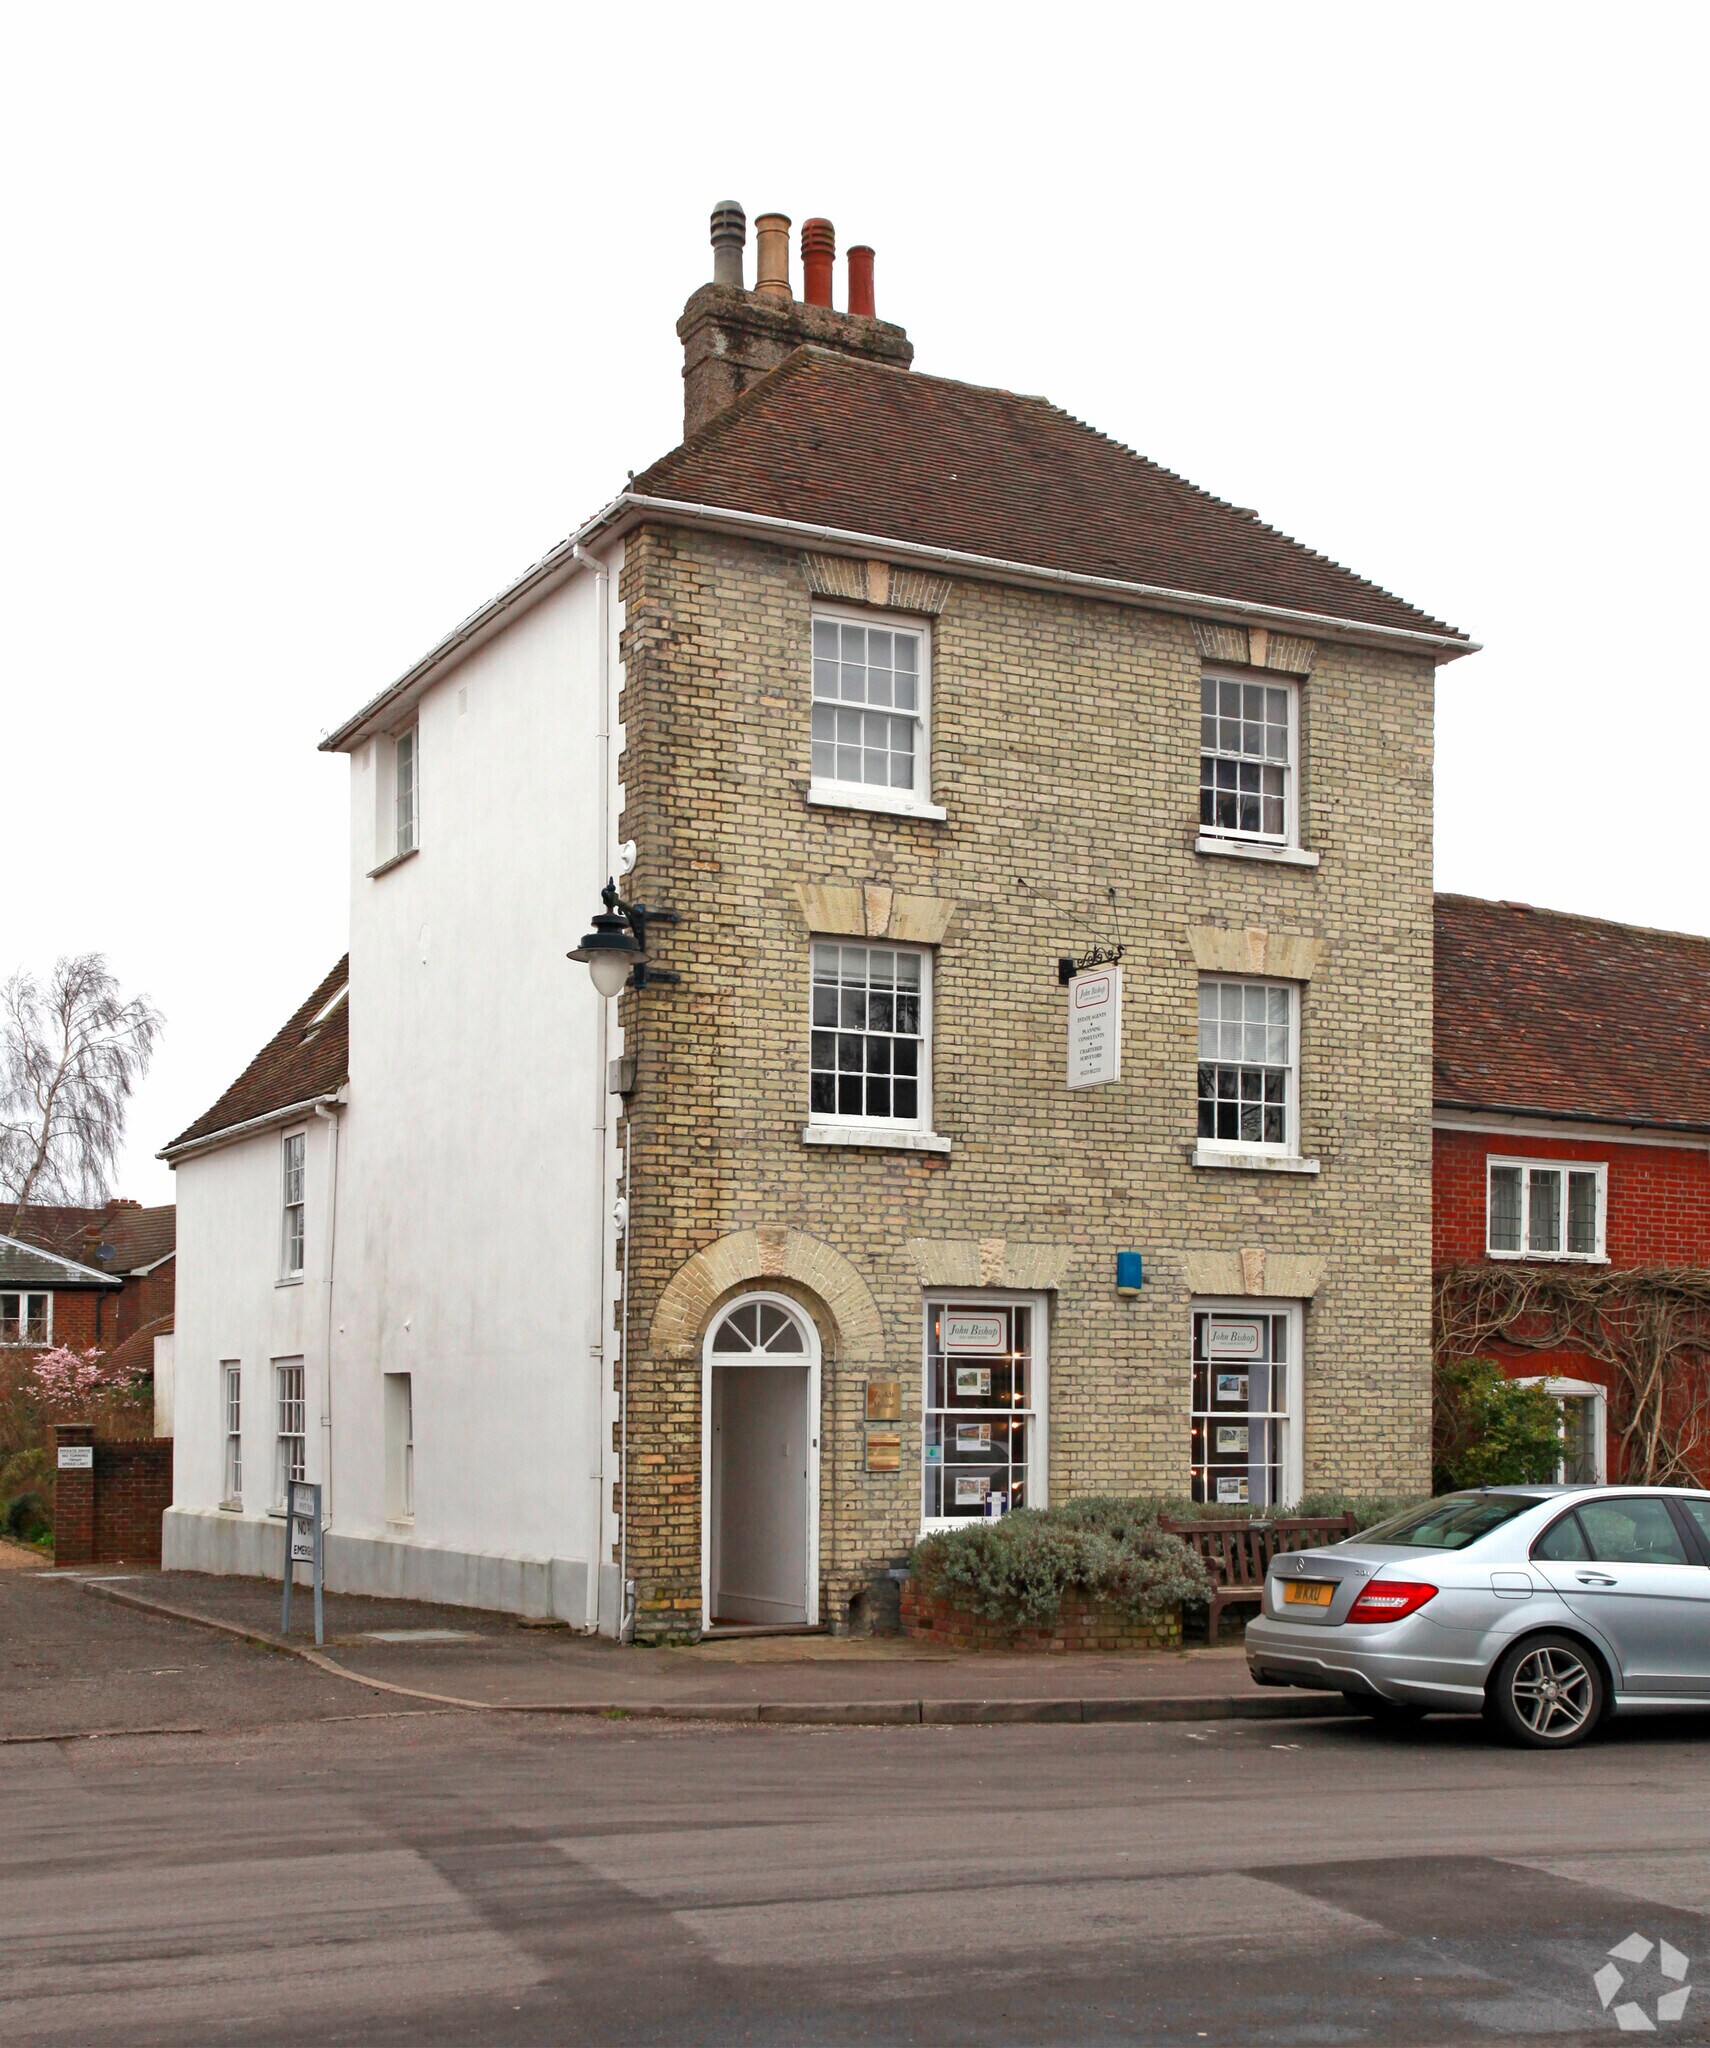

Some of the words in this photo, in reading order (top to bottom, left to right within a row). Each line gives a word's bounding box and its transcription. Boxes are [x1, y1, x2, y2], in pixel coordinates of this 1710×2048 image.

[948, 1324, 969, 1336] John
[970, 1324, 998, 1338] Bishop
[1210, 1330, 1229, 1342] John
[1230, 1331, 1256, 1344] Bishop
[297, 1520, 307, 1536] NO
